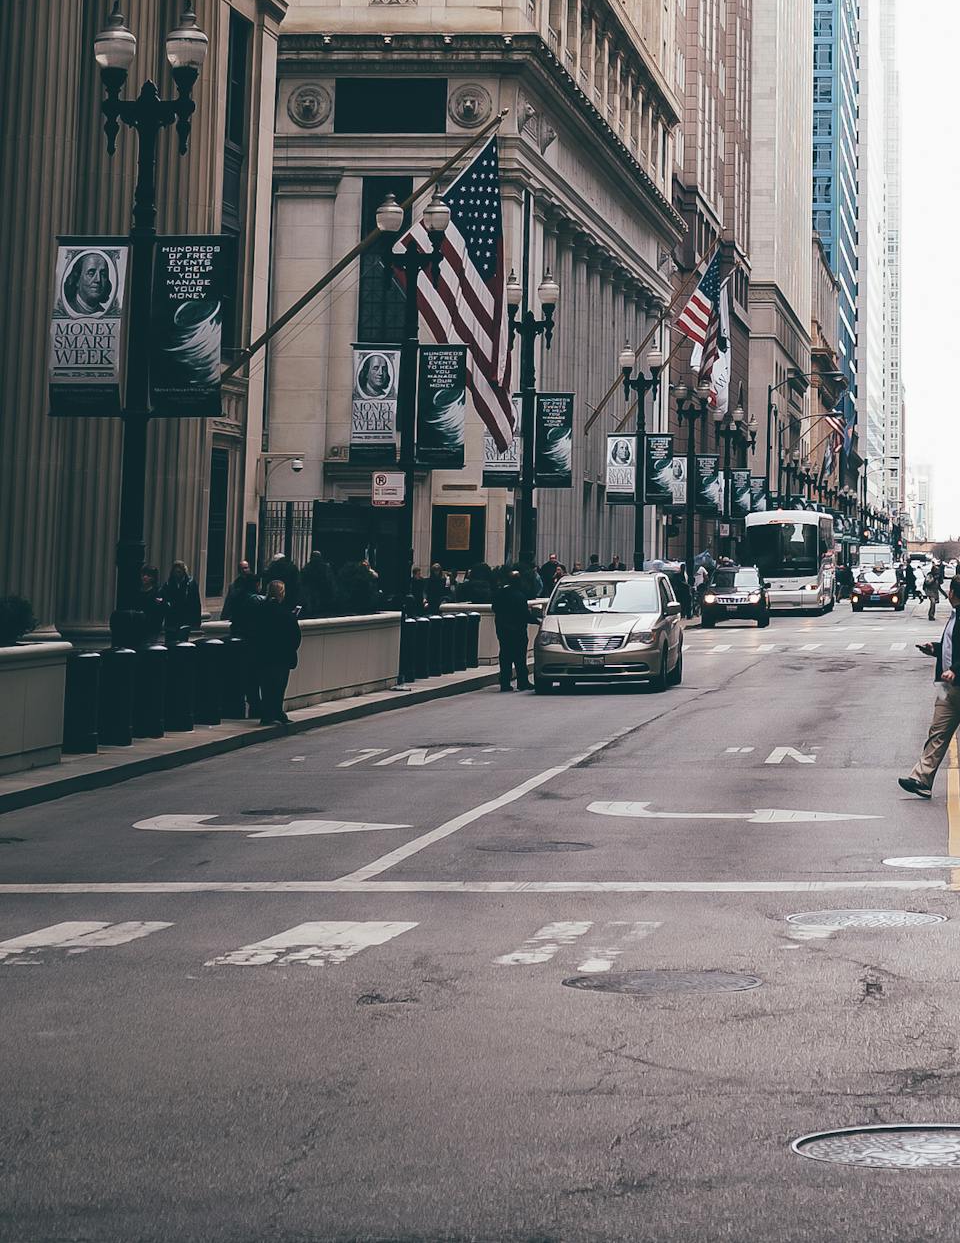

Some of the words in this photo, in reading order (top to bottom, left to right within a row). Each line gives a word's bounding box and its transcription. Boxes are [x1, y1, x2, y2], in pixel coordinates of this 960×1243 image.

[56, 323, 116, 335] MONEY
[55, 336, 115, 349] SMART
[55, 350, 115, 364] WEEK
[353, 403, 394, 411] MONEY
[353, 411, 393, 421] SMART
[353, 420, 392, 431] WEEK
